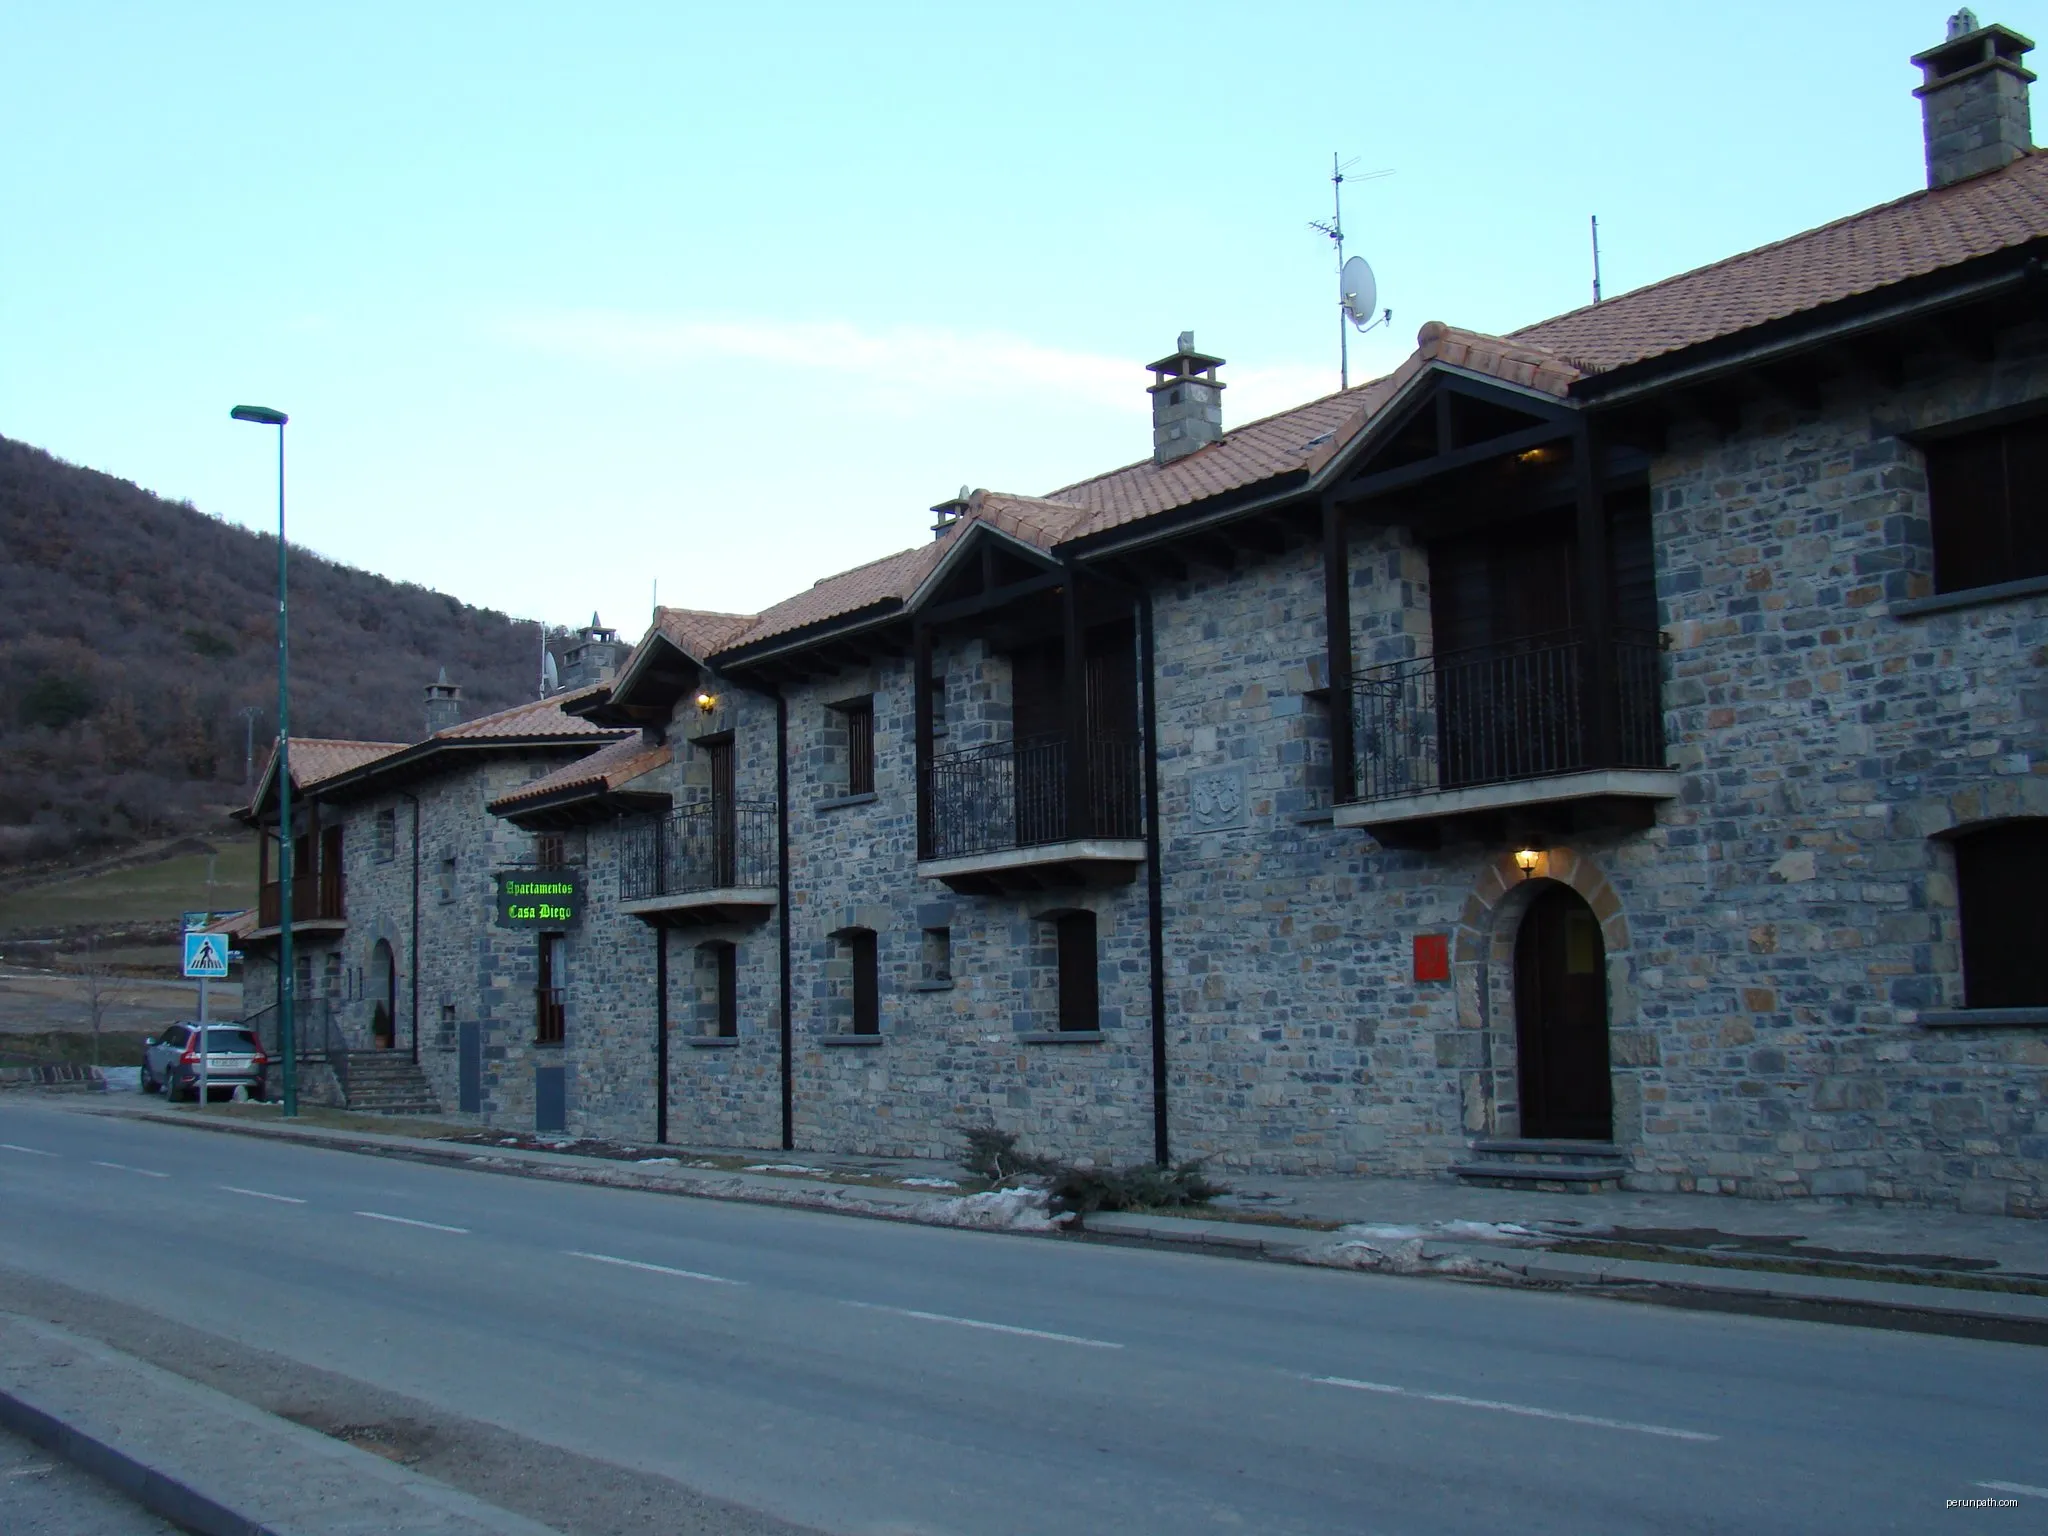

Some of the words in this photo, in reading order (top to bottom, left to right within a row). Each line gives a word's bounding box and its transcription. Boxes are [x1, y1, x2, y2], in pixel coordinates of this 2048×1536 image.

[506, 881, 573, 896] Apartamentos
[508, 904, 536, 919] Casa
[539, 903, 572, 920] Diego
